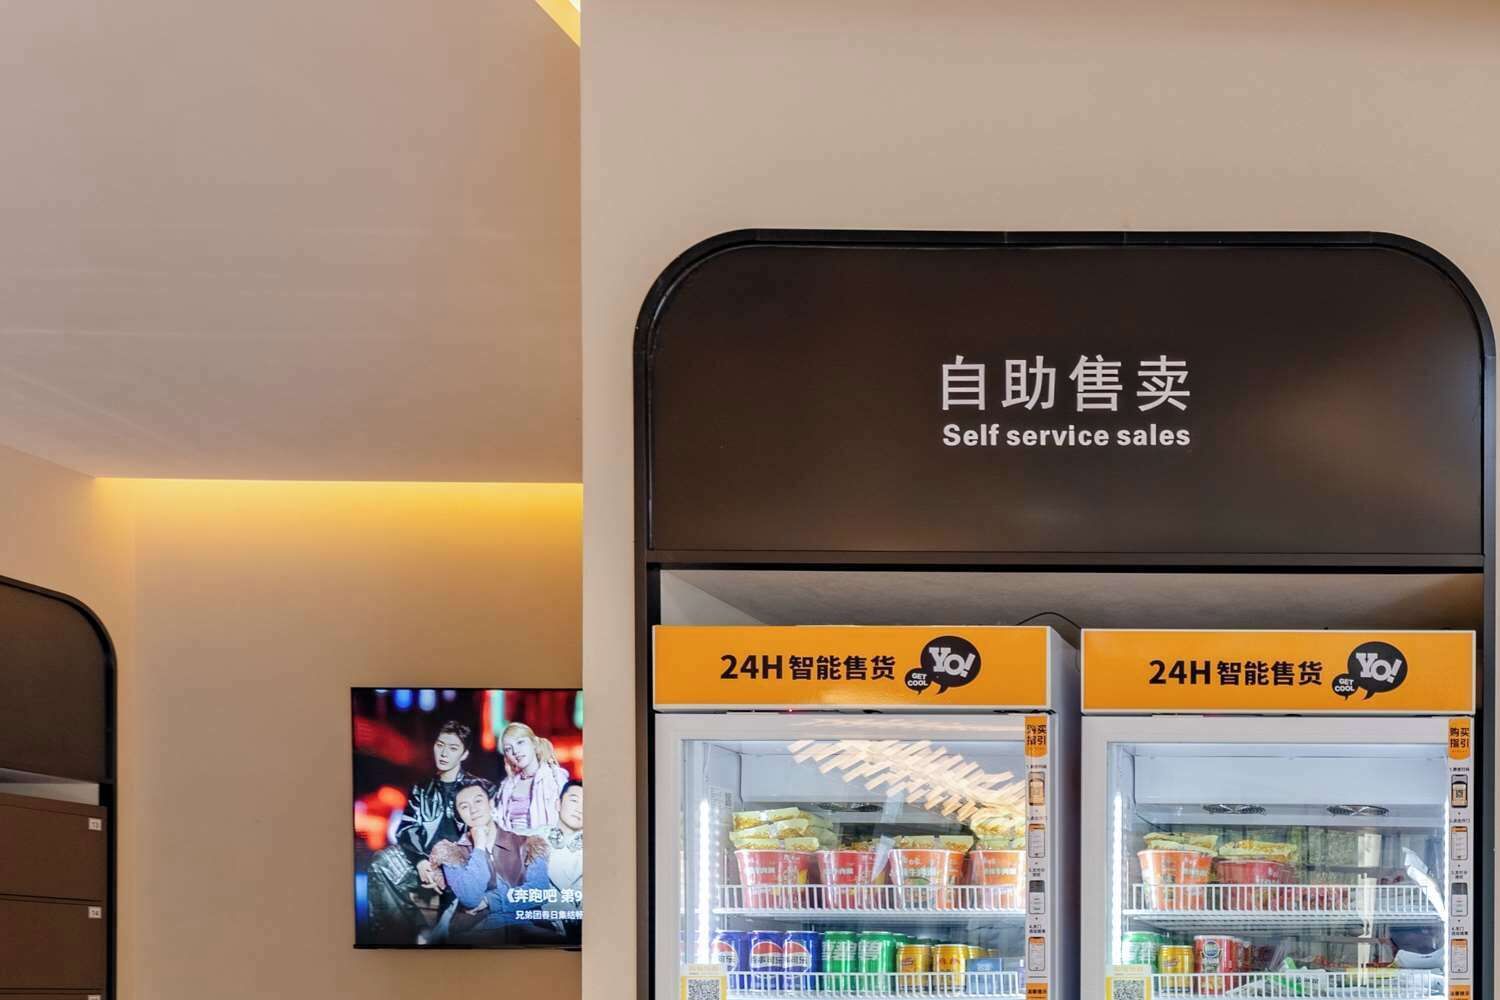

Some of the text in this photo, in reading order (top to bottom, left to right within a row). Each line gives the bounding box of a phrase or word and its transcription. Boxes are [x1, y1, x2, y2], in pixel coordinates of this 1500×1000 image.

[941, 354, 1191, 412] 自助售卖
[942, 423, 1191, 446] Self service sales
[720, 654, 896, 681] 24H 智能售货
[928, 646, 976, 678] YO!
[1148, 659, 1323, 686] 24H 智能售货
[1355, 652, 1402, 684] YO!
[907, 679, 928, 687] COOL
[911, 672, 928, 680] GET
[1338, 678, 1354, 686] GET
[1450, 727, 1470, 738] 购买
[1450, 738, 1470, 748] 指引
